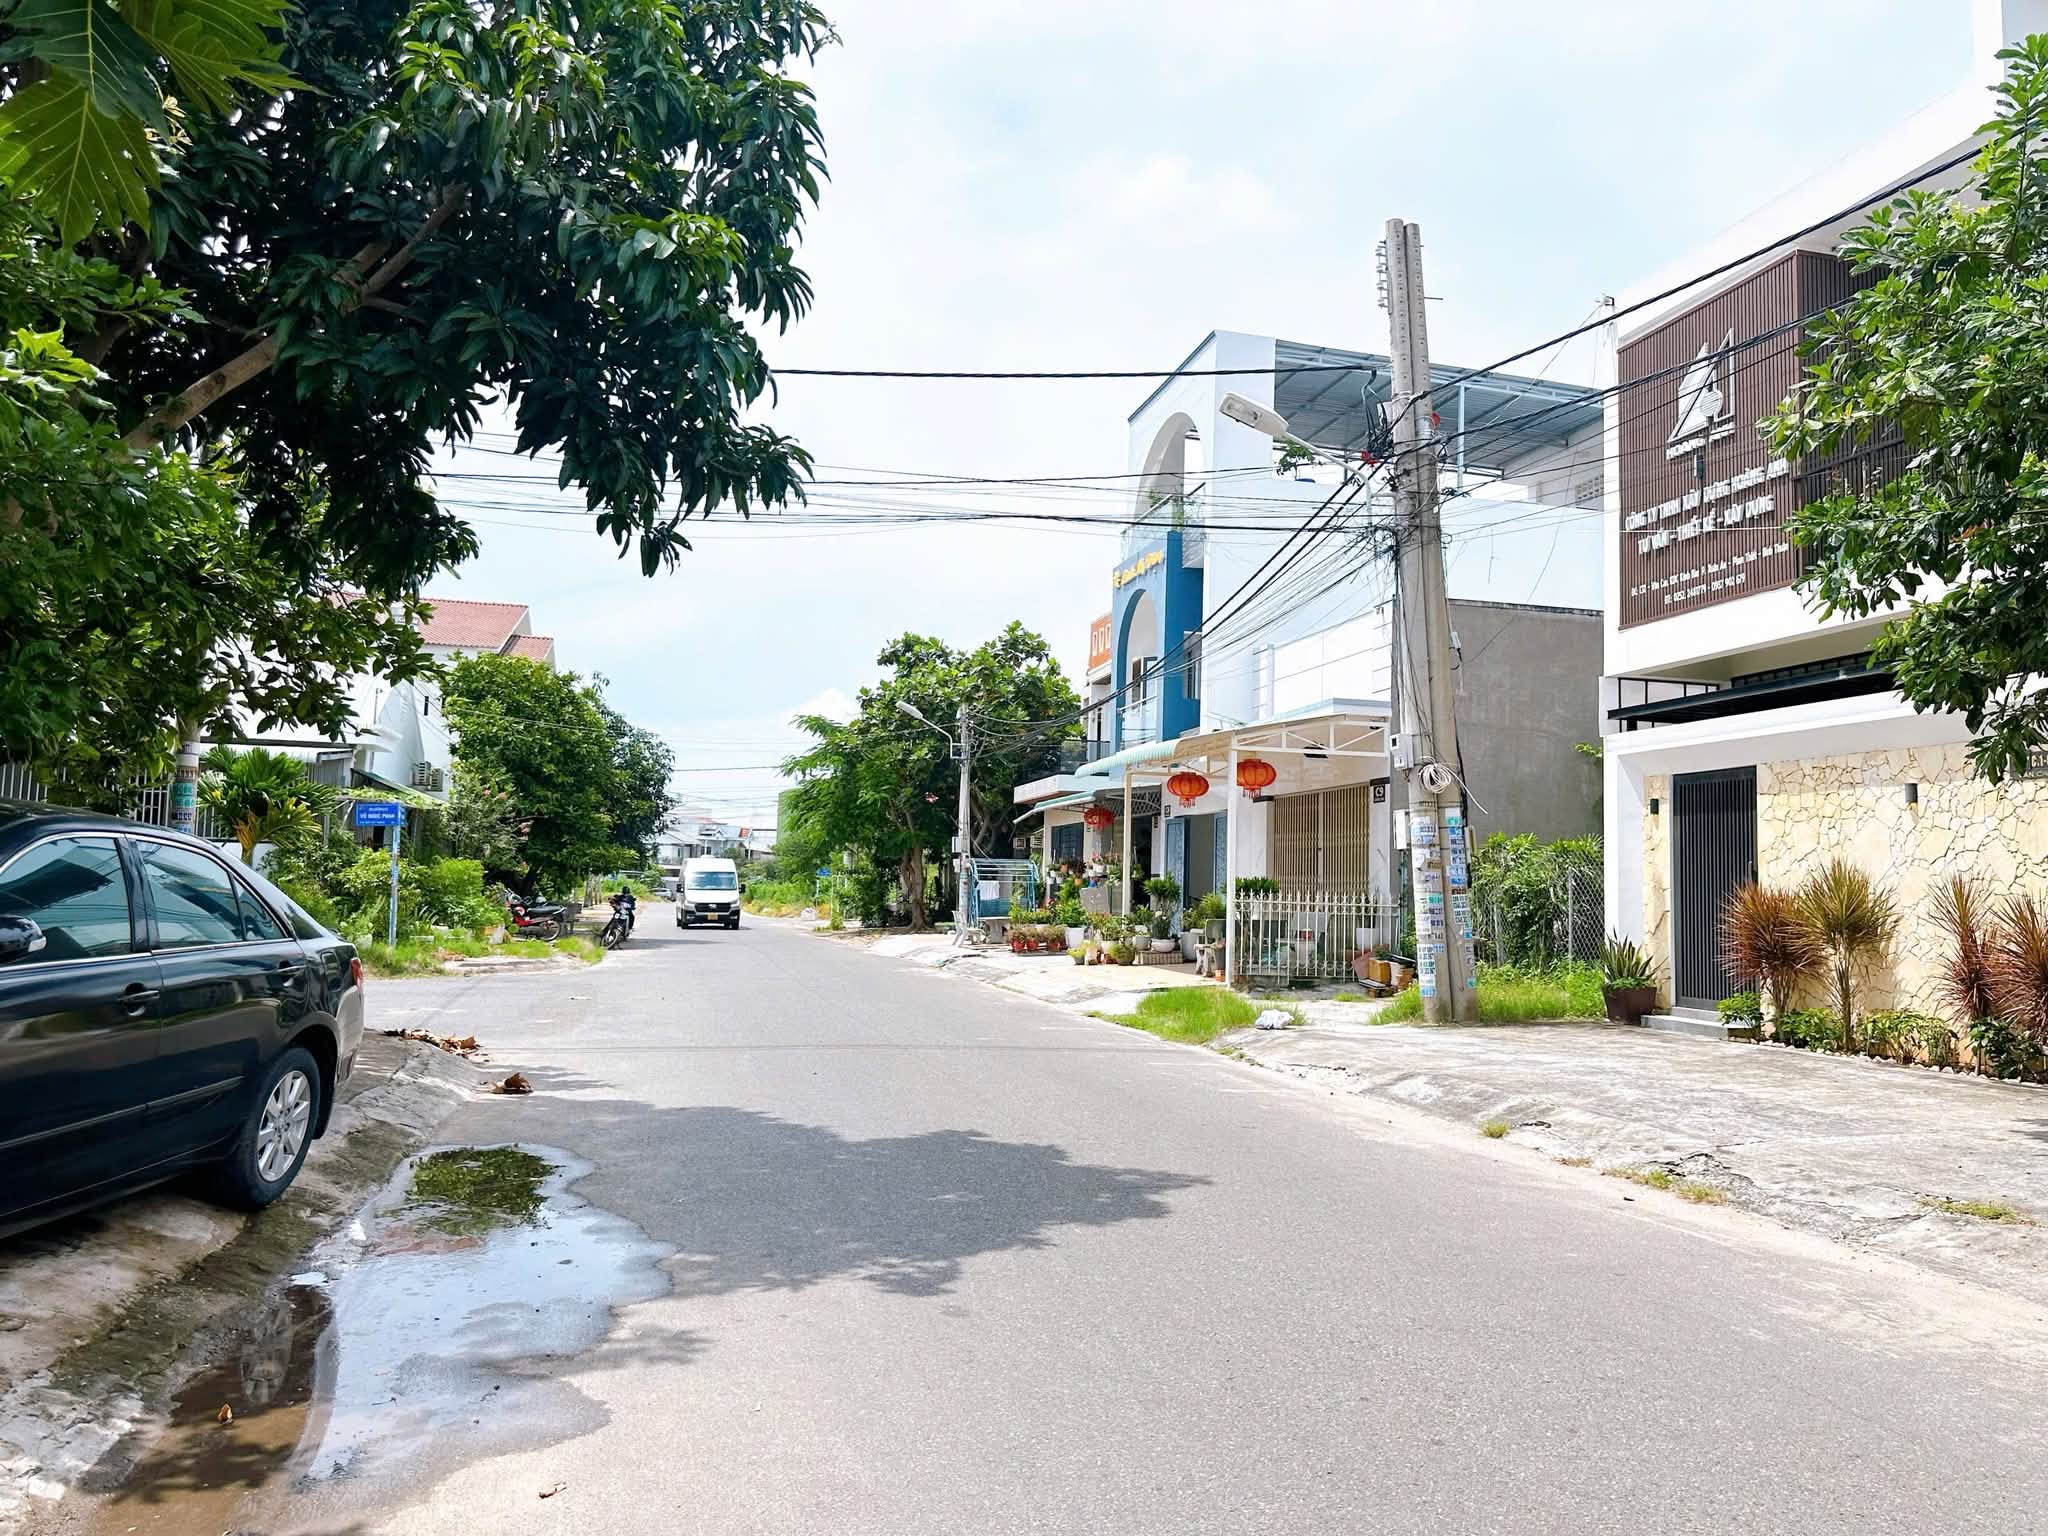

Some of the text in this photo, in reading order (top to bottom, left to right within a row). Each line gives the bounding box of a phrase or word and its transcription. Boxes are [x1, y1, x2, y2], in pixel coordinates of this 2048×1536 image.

[1626, 511, 1647, 531] CÔNG
[1647, 505, 1659, 524] TY
[1659, 498, 1681, 519] TNHH
[1682, 489, 1701, 512] XÂY
[1724, 503, 1744, 526] XÂY
[1745, 495, 1776, 519] DỰNG
